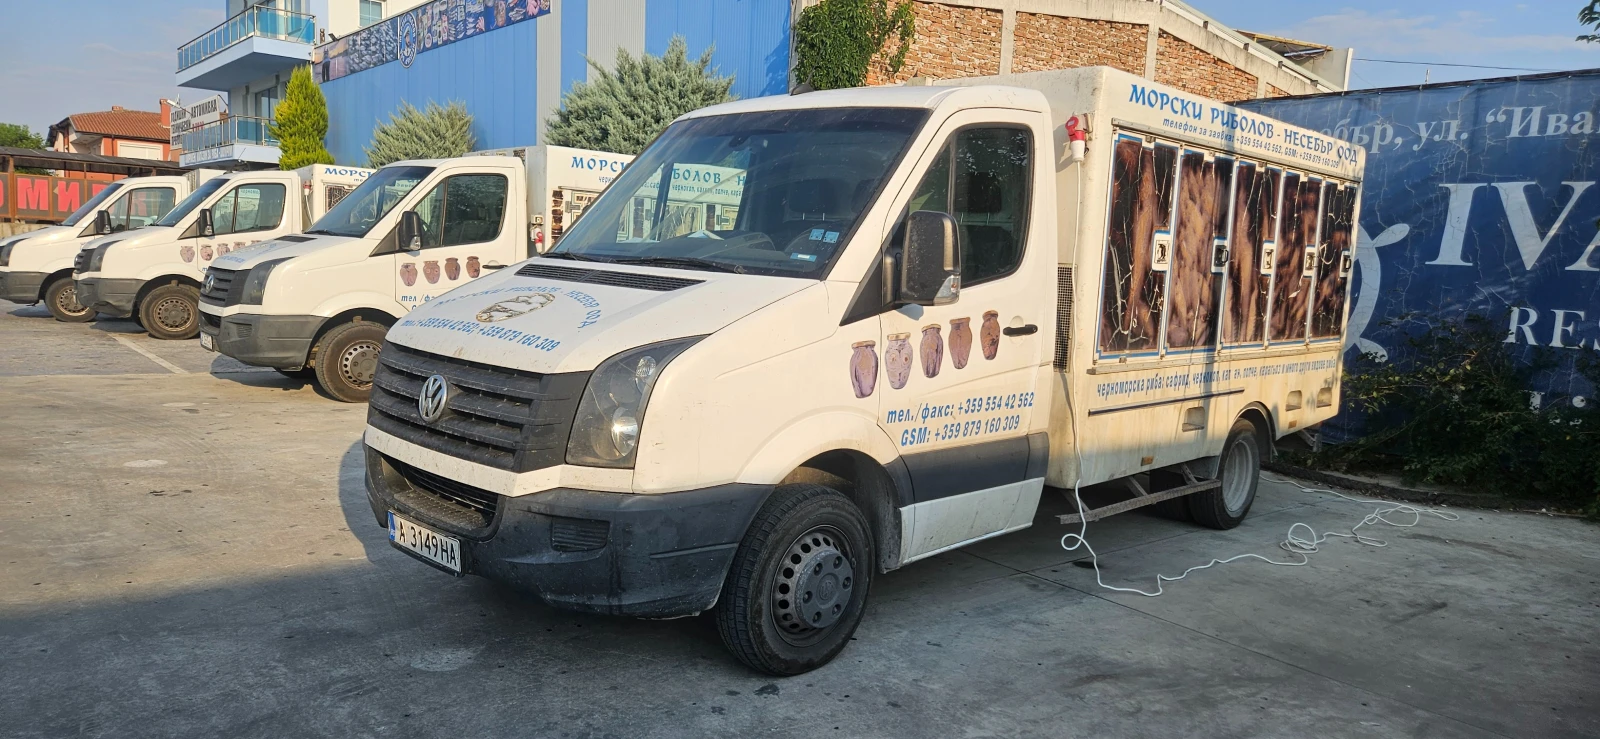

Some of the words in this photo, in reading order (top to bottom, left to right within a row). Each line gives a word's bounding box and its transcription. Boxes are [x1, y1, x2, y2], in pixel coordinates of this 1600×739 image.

[1128, 83, 1203, 121] МОРСКИ
[1210, 107, 1274, 139] РИБОЛОВ
[1284, 128, 1333, 155] НЕСЕБЪР
[1337, 145, 1358, 167] ООД
[1162, 118, 1198, 134] телефон
[1198, 127, 1207, 136] за
[1208, 128, 1234, 143] заявка:
[1236, 135, 1251, 147] +359
[1252, 138, 1263, 149] 554
[1264, 141, 1271, 151] 42
[1284, 146, 1299, 159] GSM:
[1299, 150, 1312, 162] +359
[1312, 153, 1321, 163] 879
[1412, 119, 1469, 151] ул.
[1485, 105, 1600, 139] “Ива
[671, 168, 722, 184] БОЛОВ
[499, 328, 522, 342] 879
[517, 332, 541, 347] 160
[535, 338, 561, 352] 309
[1502, 306, 1600, 351] RE
[1097, 378, 1144, 401] черноморска
[1145, 372, 1164, 396] риба:
[886, 402, 955, 425] тел./факс:
[957, 397, 983, 416] +359
[985, 395, 1003, 412] 554
[1004, 393, 1016, 410] 42
[1017, 391, 1035, 409] 562
[900, 426, 931, 447] GSM:
[935, 421, 961, 442] +359
[962, 419, 982, 437] 879
[984, 416, 1002, 435] 160
[1002, 414, 1020, 432] 309
